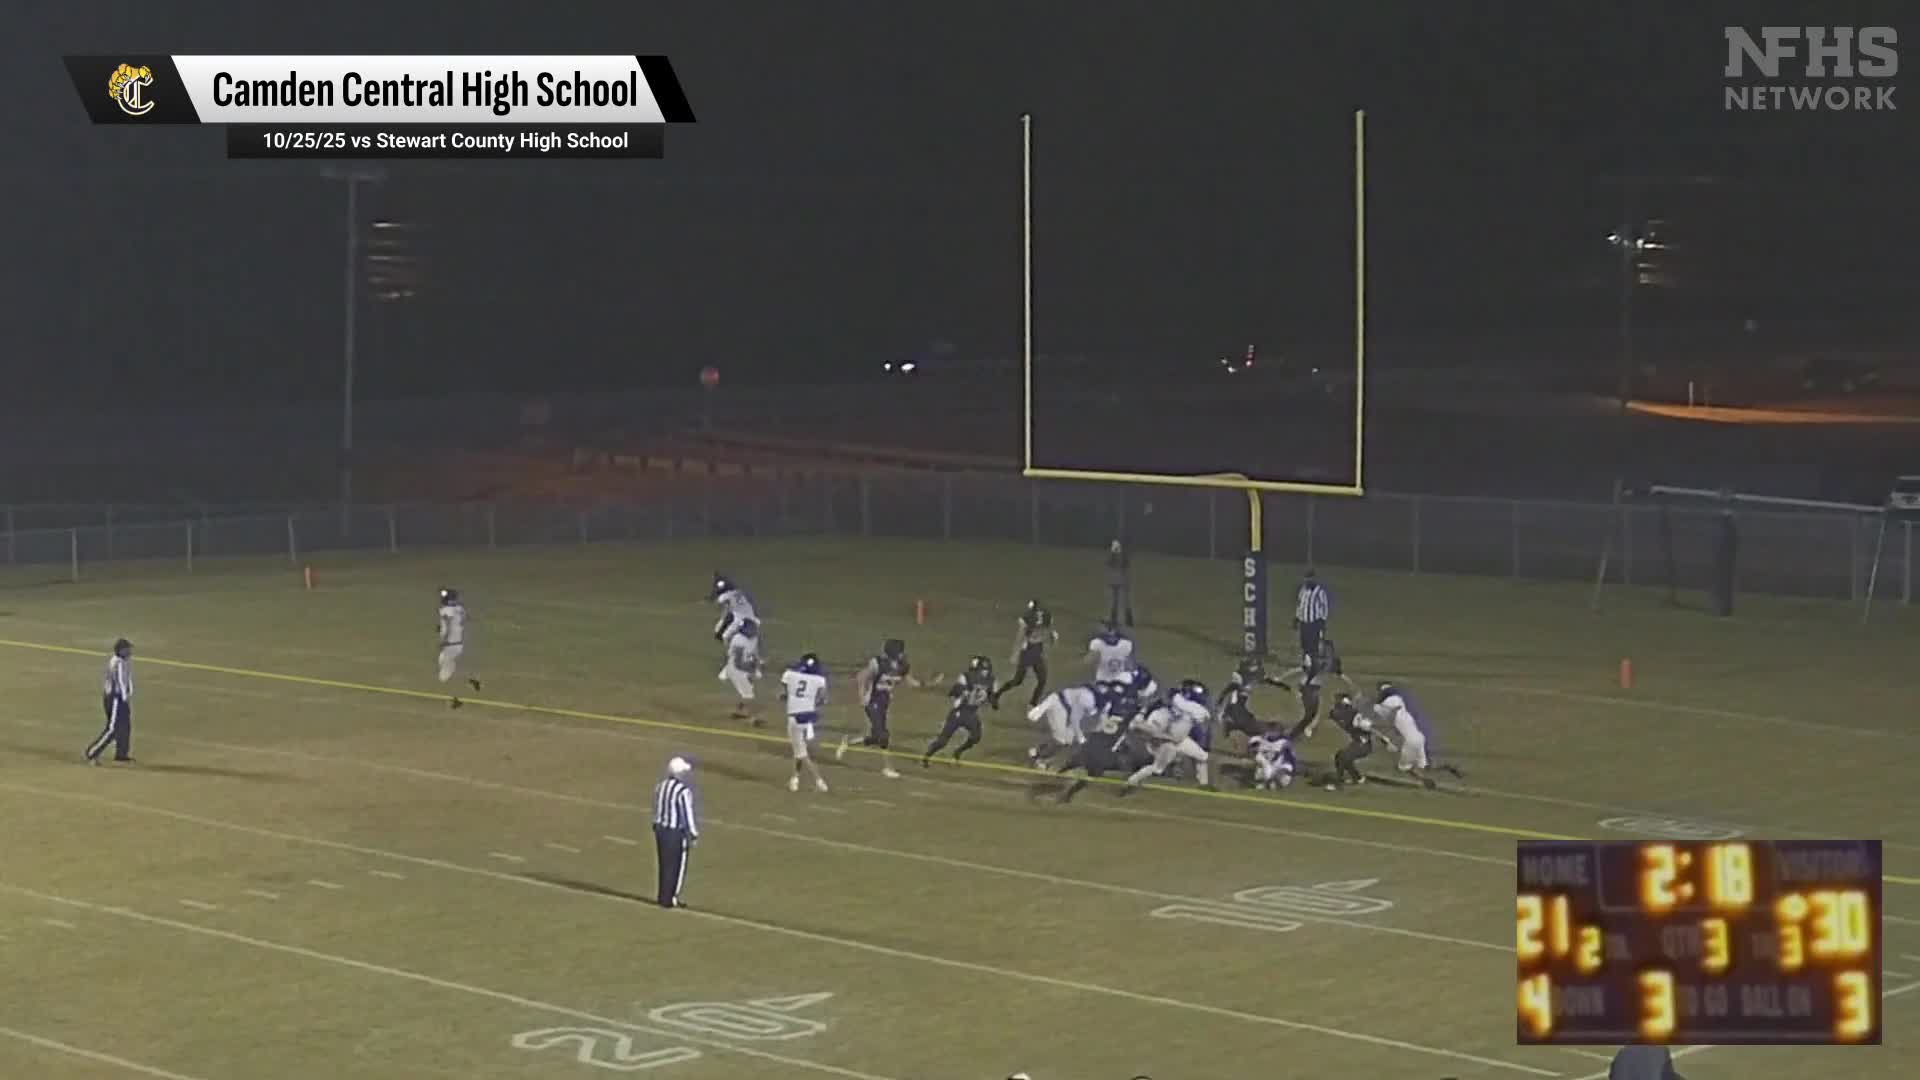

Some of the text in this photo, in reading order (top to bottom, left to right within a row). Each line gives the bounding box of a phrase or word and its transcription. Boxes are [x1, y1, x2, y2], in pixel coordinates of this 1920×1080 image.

[1244, 557, 1257, 652] SCHS
[795, 680, 808, 698] 2
[1150, 885, 1393, 932] 10
[512, 1002, 827, 1071] 20
